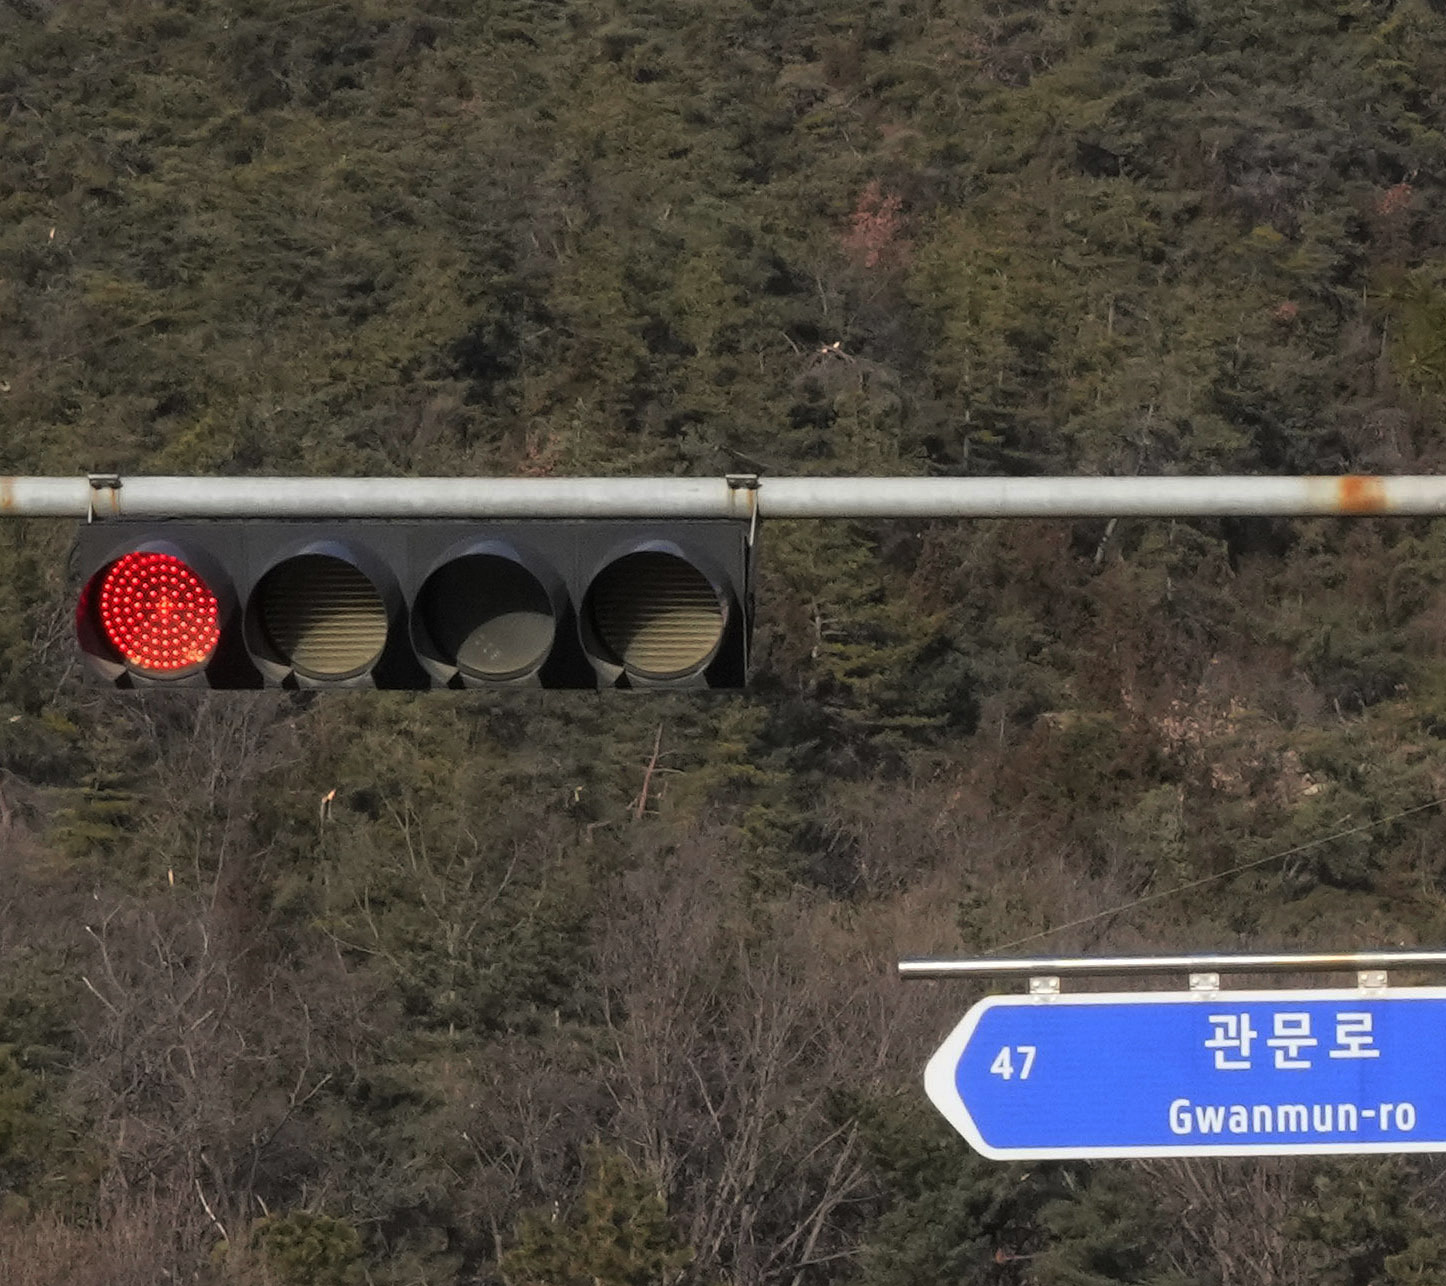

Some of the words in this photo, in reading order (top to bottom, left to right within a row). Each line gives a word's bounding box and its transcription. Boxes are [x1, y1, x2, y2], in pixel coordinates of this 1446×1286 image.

[1204, 1012, 1381, 1071] 관문로
[990, 1045, 1038, 1081] 47
[1168, 1099, 1417, 1136] Gwanmun-ro
